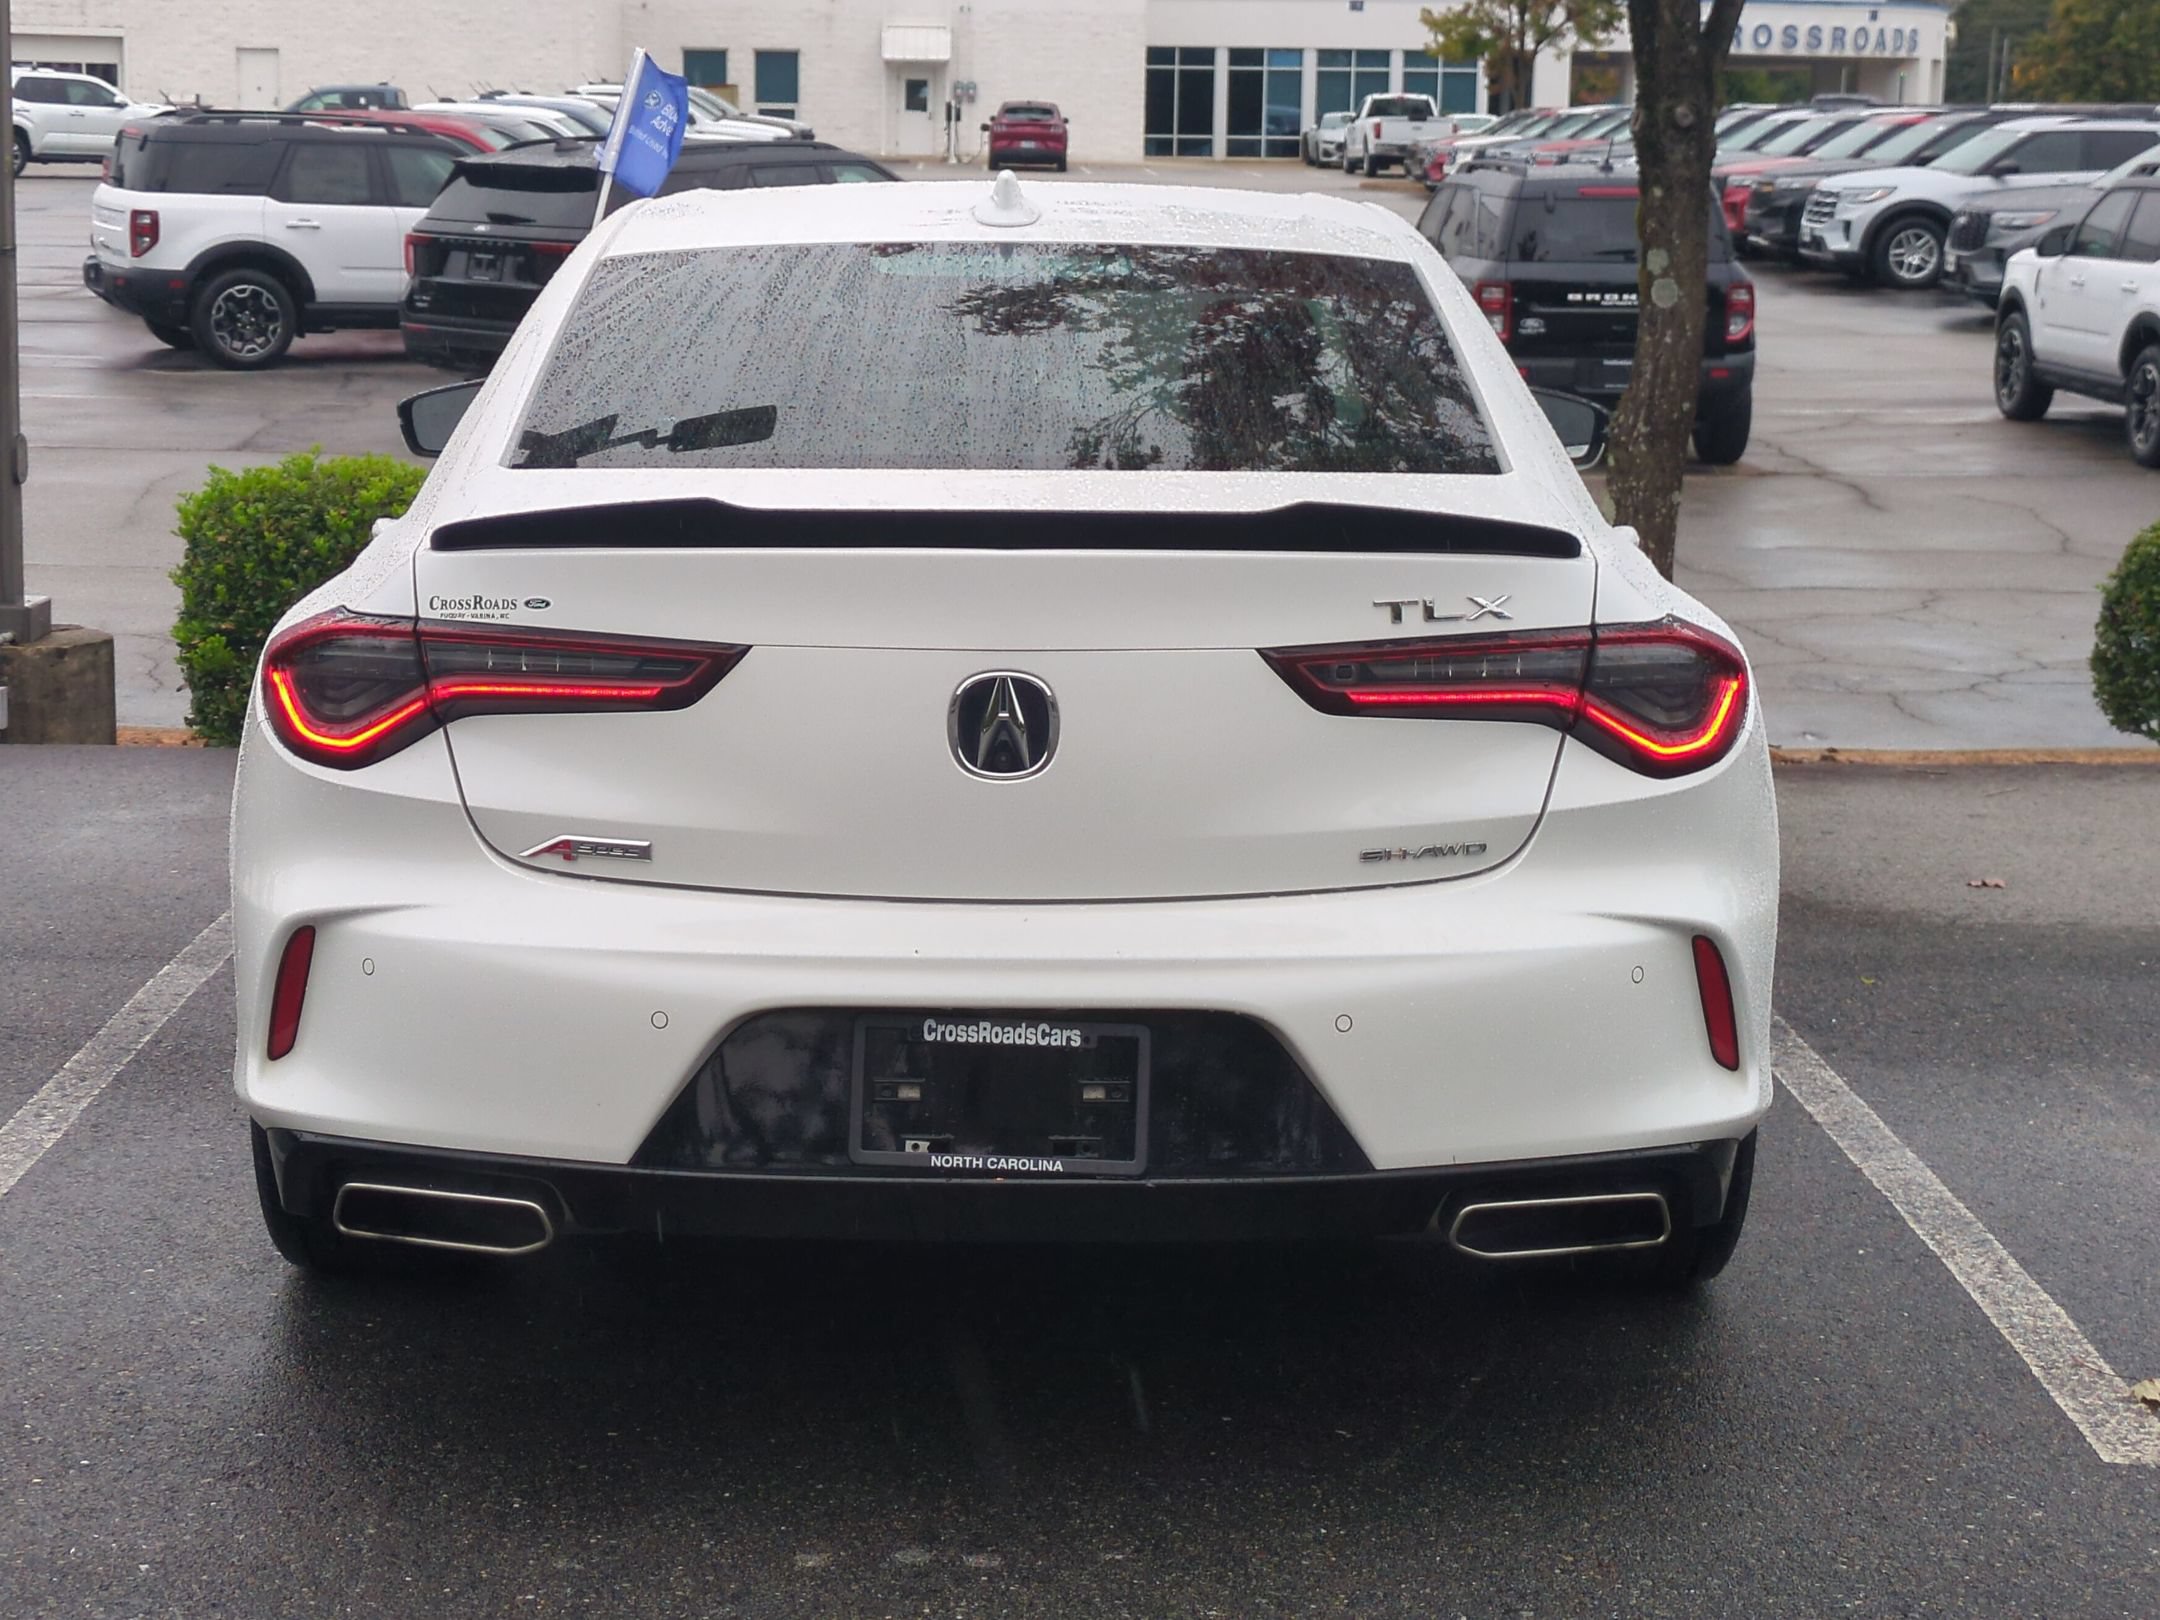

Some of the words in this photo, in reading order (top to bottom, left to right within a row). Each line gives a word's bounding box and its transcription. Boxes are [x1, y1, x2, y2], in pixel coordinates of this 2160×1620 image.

[1733, 24, 1918, 51] ROSSROADS
[1373, 595, 1513, 624] TLX
[1360, 842, 1487, 862] SH-AWD
[923, 1018, 1081, 1047] CrossRoadsCars
[931, 1155, 983, 1169] NORTH
[987, 1157, 1063, 1172] CAROLINA
